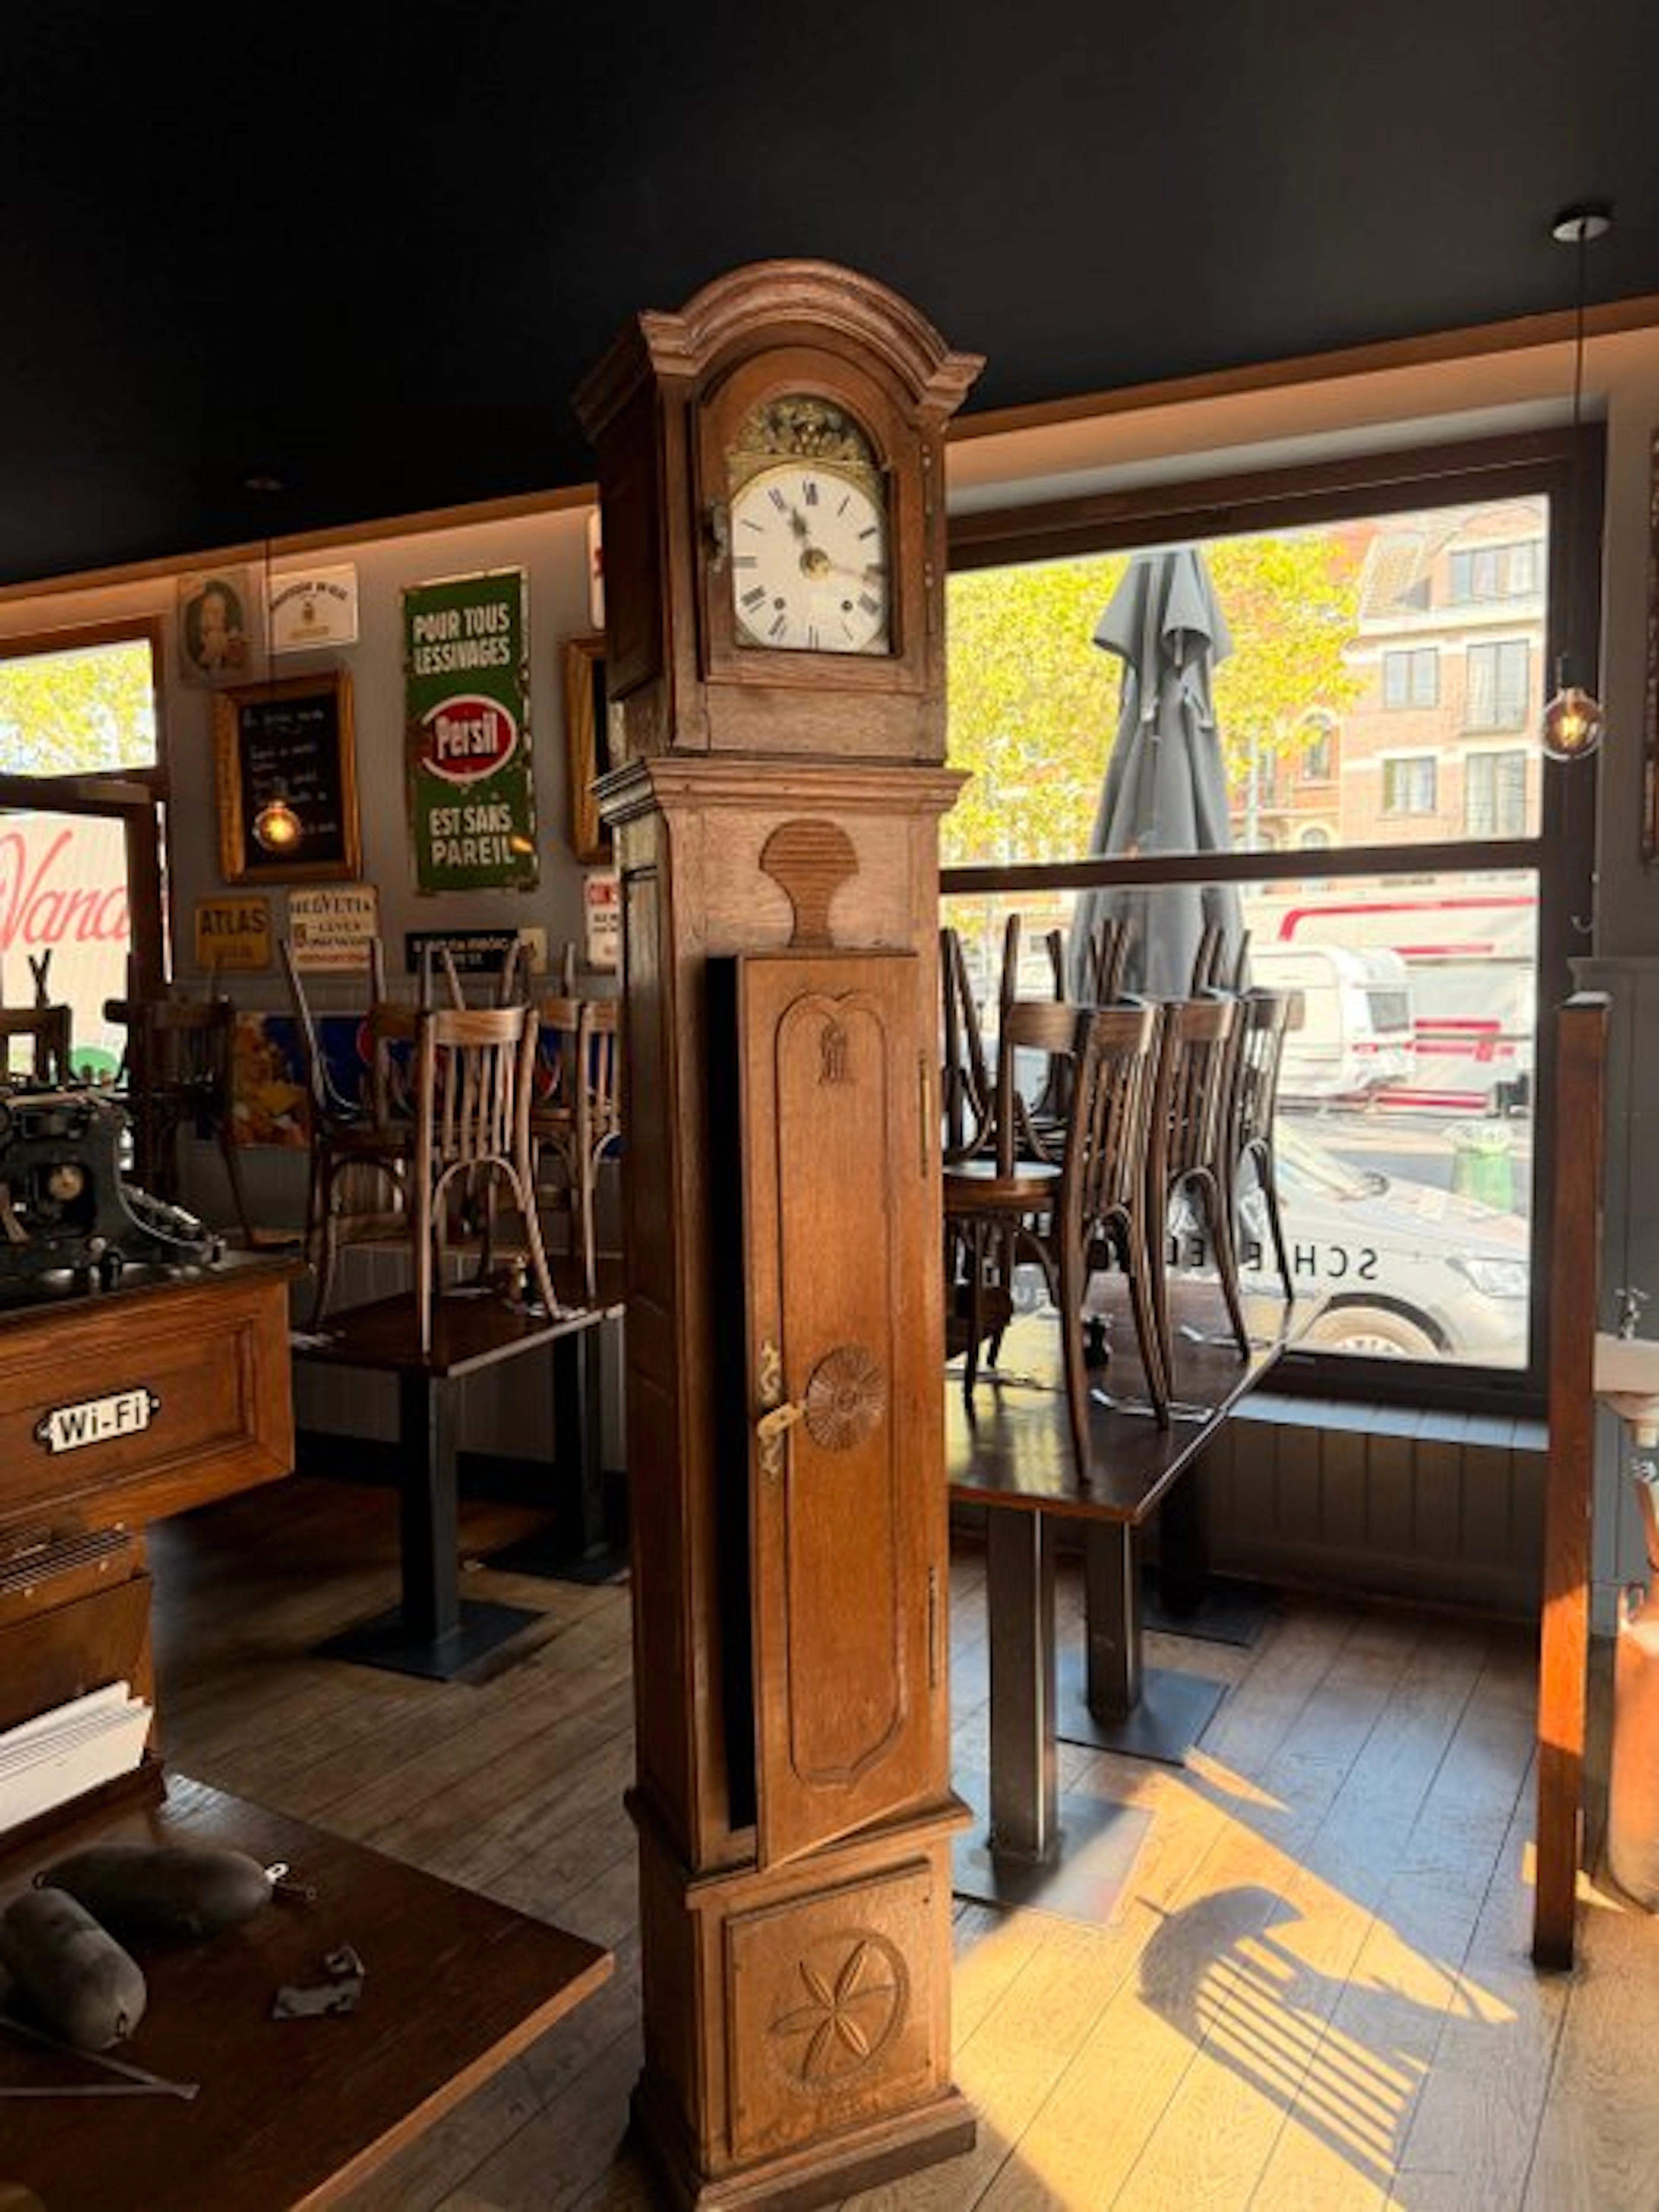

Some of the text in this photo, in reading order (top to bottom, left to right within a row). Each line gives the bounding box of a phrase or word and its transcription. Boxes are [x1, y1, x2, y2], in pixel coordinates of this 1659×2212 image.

[413, 602, 510, 642] POUR TOUS
[413, 637, 510, 675] LESSIVAGES
[436, 711, 499, 760] Persil
[431, 804, 513, 836] EST SANS
[432, 837, 515, 865] PAREIL
[200, 908, 268, 935] ATLAS
[59, 1397, 141, 1444] Wi-Fi
